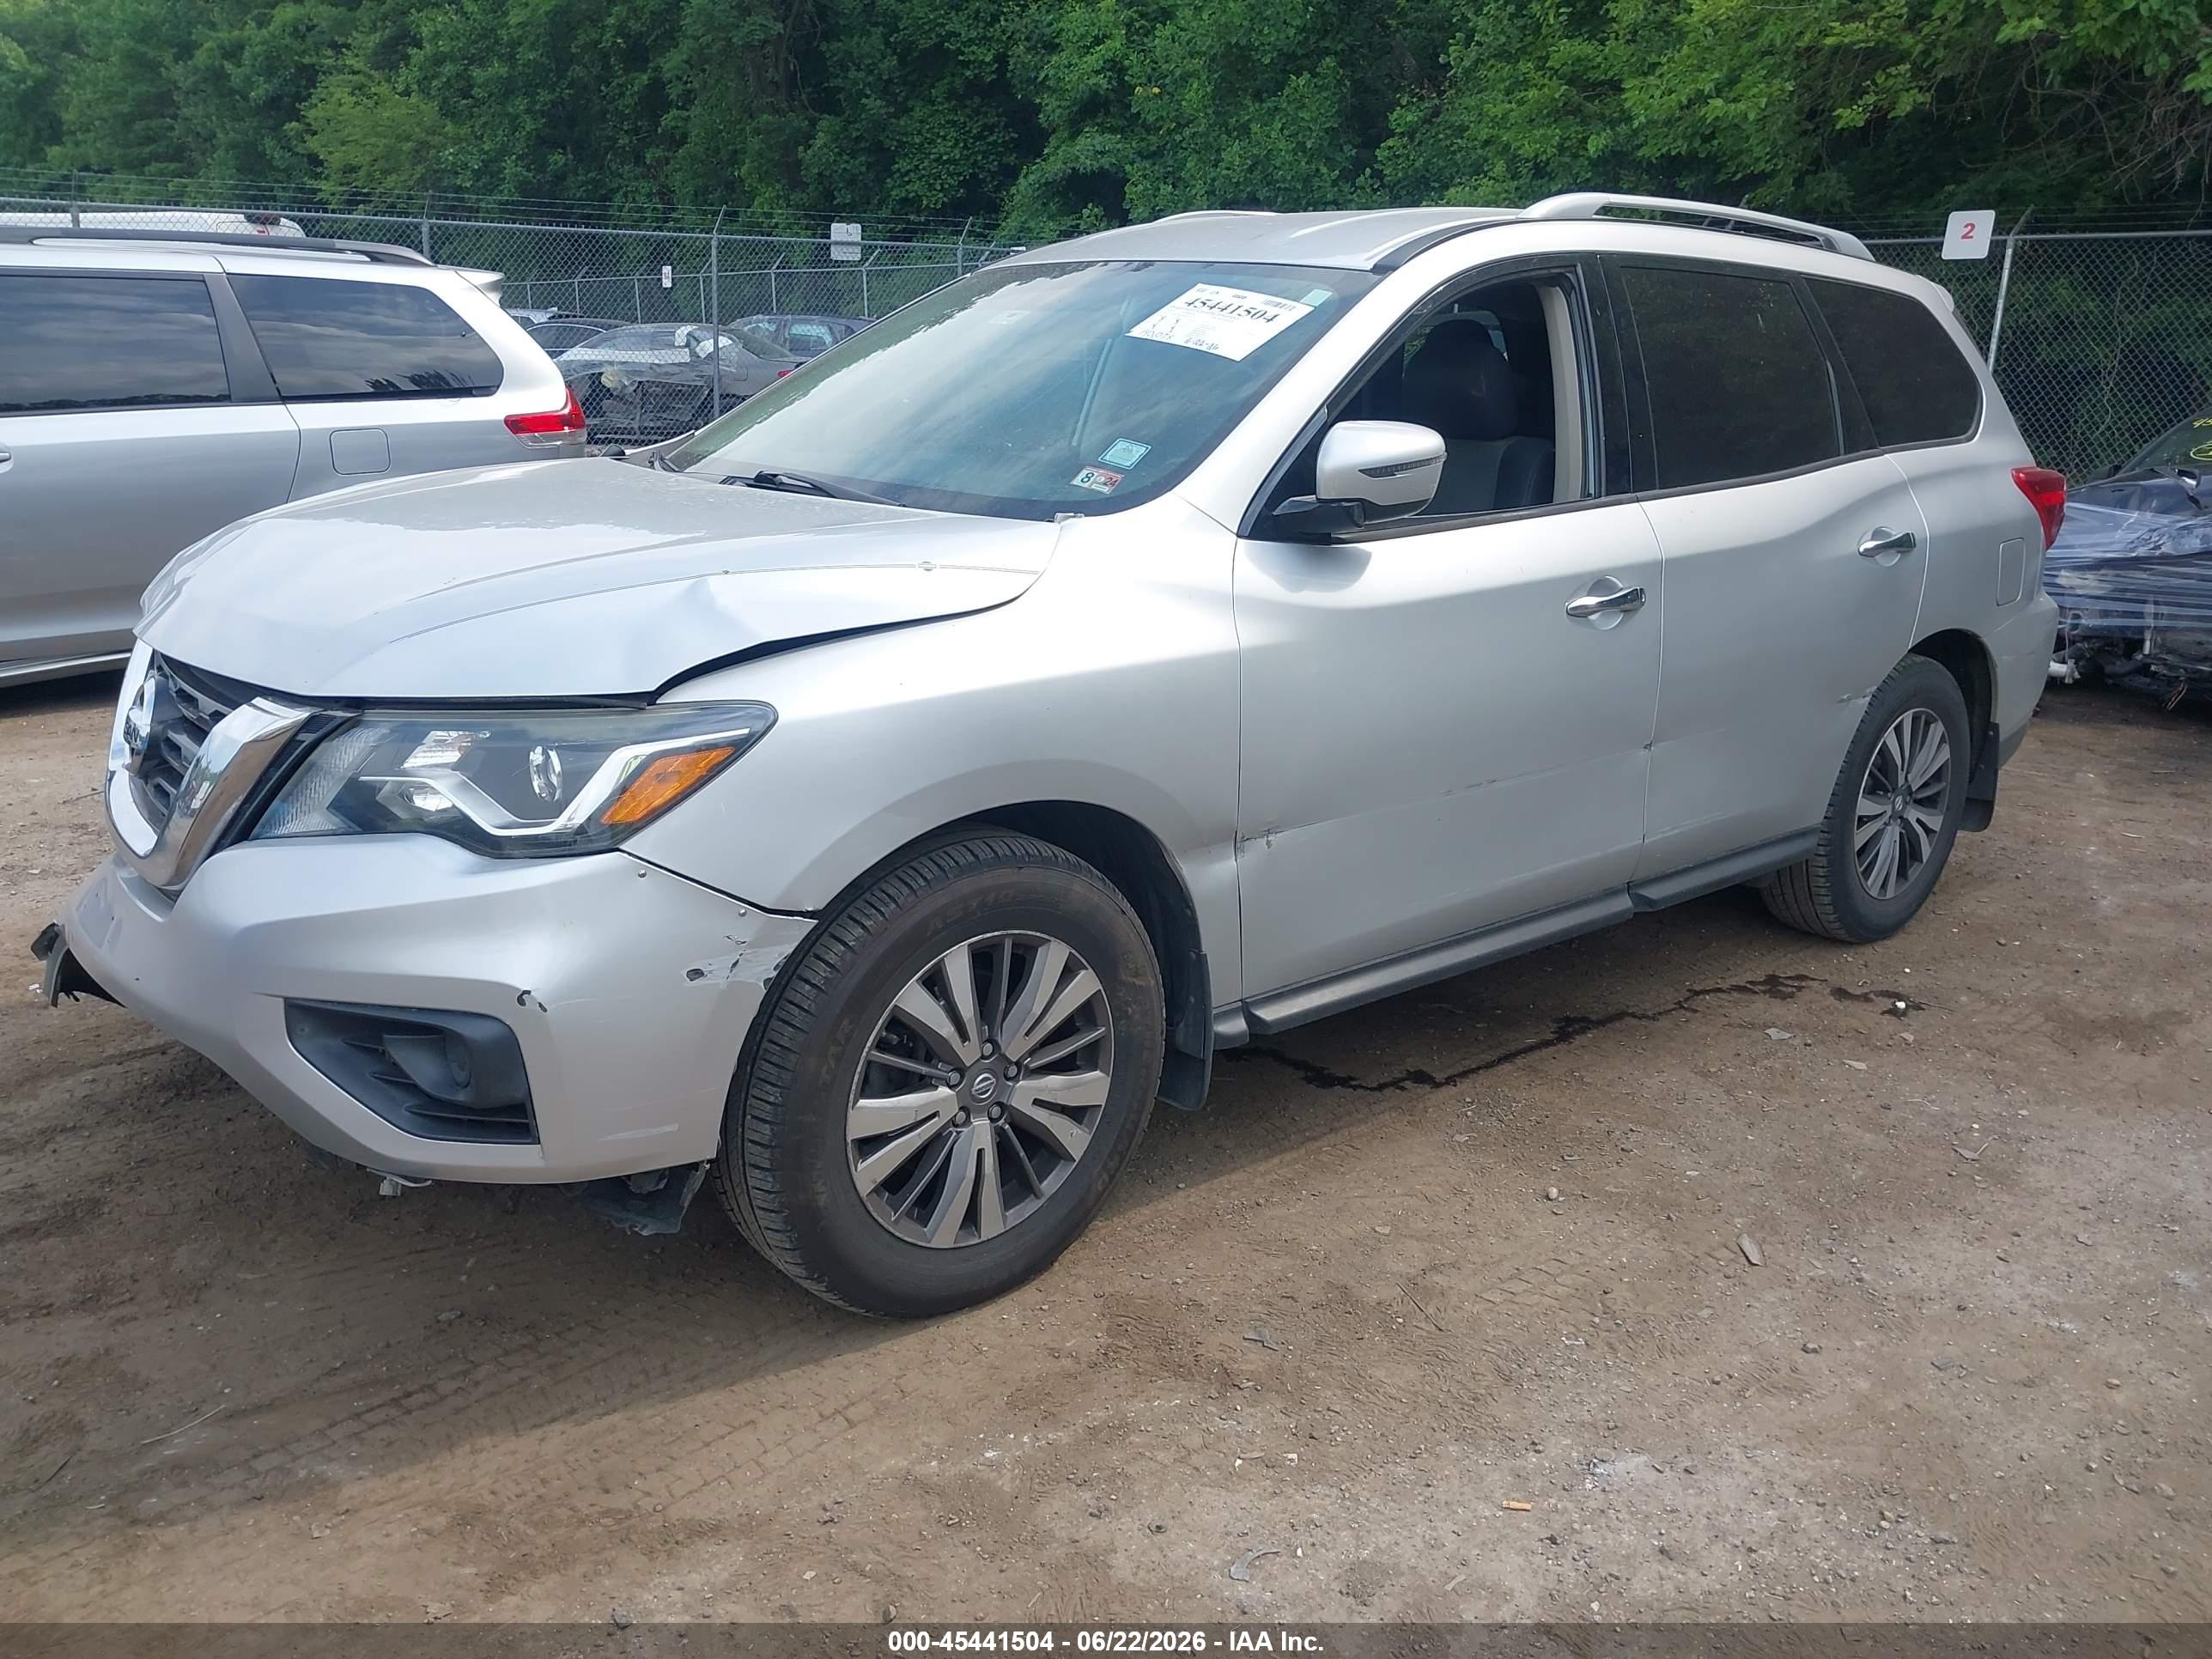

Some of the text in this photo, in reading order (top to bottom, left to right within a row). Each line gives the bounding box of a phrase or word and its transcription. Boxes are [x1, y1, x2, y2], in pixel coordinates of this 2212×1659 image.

[1960, 222, 1976, 240] 2
[1184, 297, 1279, 324] 45441504
[1080, 471, 1095, 483] 8
